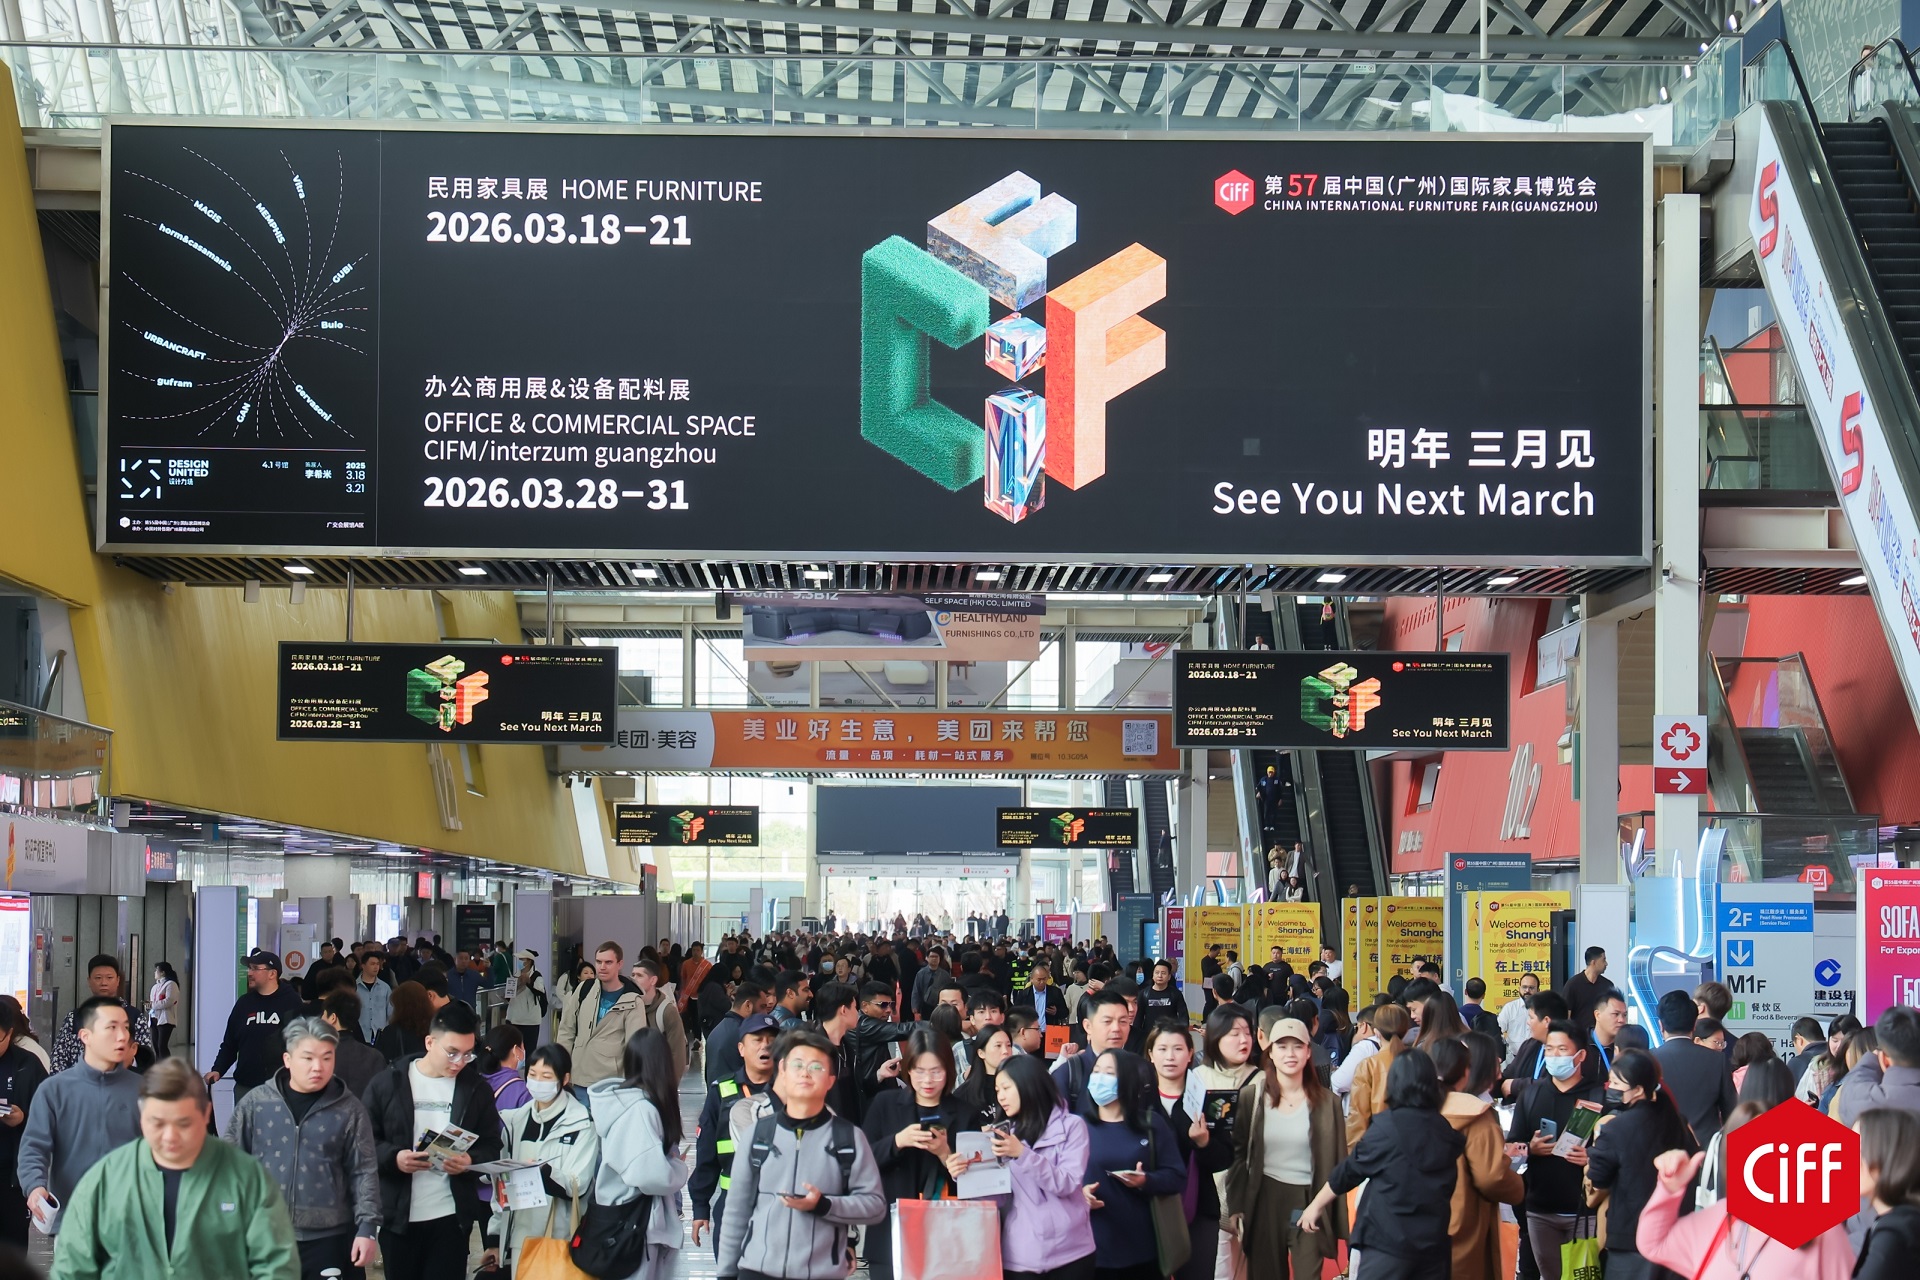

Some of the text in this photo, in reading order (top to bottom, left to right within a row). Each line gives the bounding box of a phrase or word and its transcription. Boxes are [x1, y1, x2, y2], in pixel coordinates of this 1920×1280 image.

[292, 174, 305, 200] Vitra
[427, 176, 763, 202] 民用家具展 HOME FURNITURE
[193, 200, 222, 224] MAGIS
[1264, 200, 1599, 214] CHINA INTERNATIONAL FURNITURE FAIR(GUANGZHOU)
[256, 202, 286, 244] MEMPHIS
[158, 224, 232, 273] horm&casamania
[321, 321, 343, 329] Bulo
[144, 331, 206, 360] URBANCRAFT
[157, 378, 192, 388] gufram
[424, 375, 691, 401] 办公商用展&设备配料展
[424, 412, 756, 437] OFFICE & COMMERCIAL SPACE
[424, 439, 717, 468] CIFM/interzum guangzhou
[1367, 427, 1596, 469] 明年 三月见
[168, 460, 209, 468] DESIGN
[168, 468, 209, 477] UNITED
[345, 470, 366, 480] 3.18
[345, 484, 365, 493] 3.21
[1212, 481, 1594, 516] See You Next March
[969, 599, 985, 607] (HK)
[1001, 600, 1031, 608] LIMITED
[953, 613, 1027, 623] HEALTHYLAND
[945, 630, 1001, 638] FURNISHINGS
[541, 711, 602, 722] 明年 三月见
[1432, 717, 1492, 727] 明年 三月见
[500, 722, 602, 732] See You Next March
[1392, 728, 1492, 738] See You Next March
[1728, 907, 1753, 927] 2F
[1880, 905, 1920, 938] SOFA
[1489, 920, 1550, 929] Welcome to
[1278, 926, 1315, 935] Shanghai
[1880, 946, 1895, 954] For
[1727, 974, 1767, 994] M1F
[1751, 1002, 1782, 1012] 餐饮区
[246, 1011, 281, 1026] FILA
